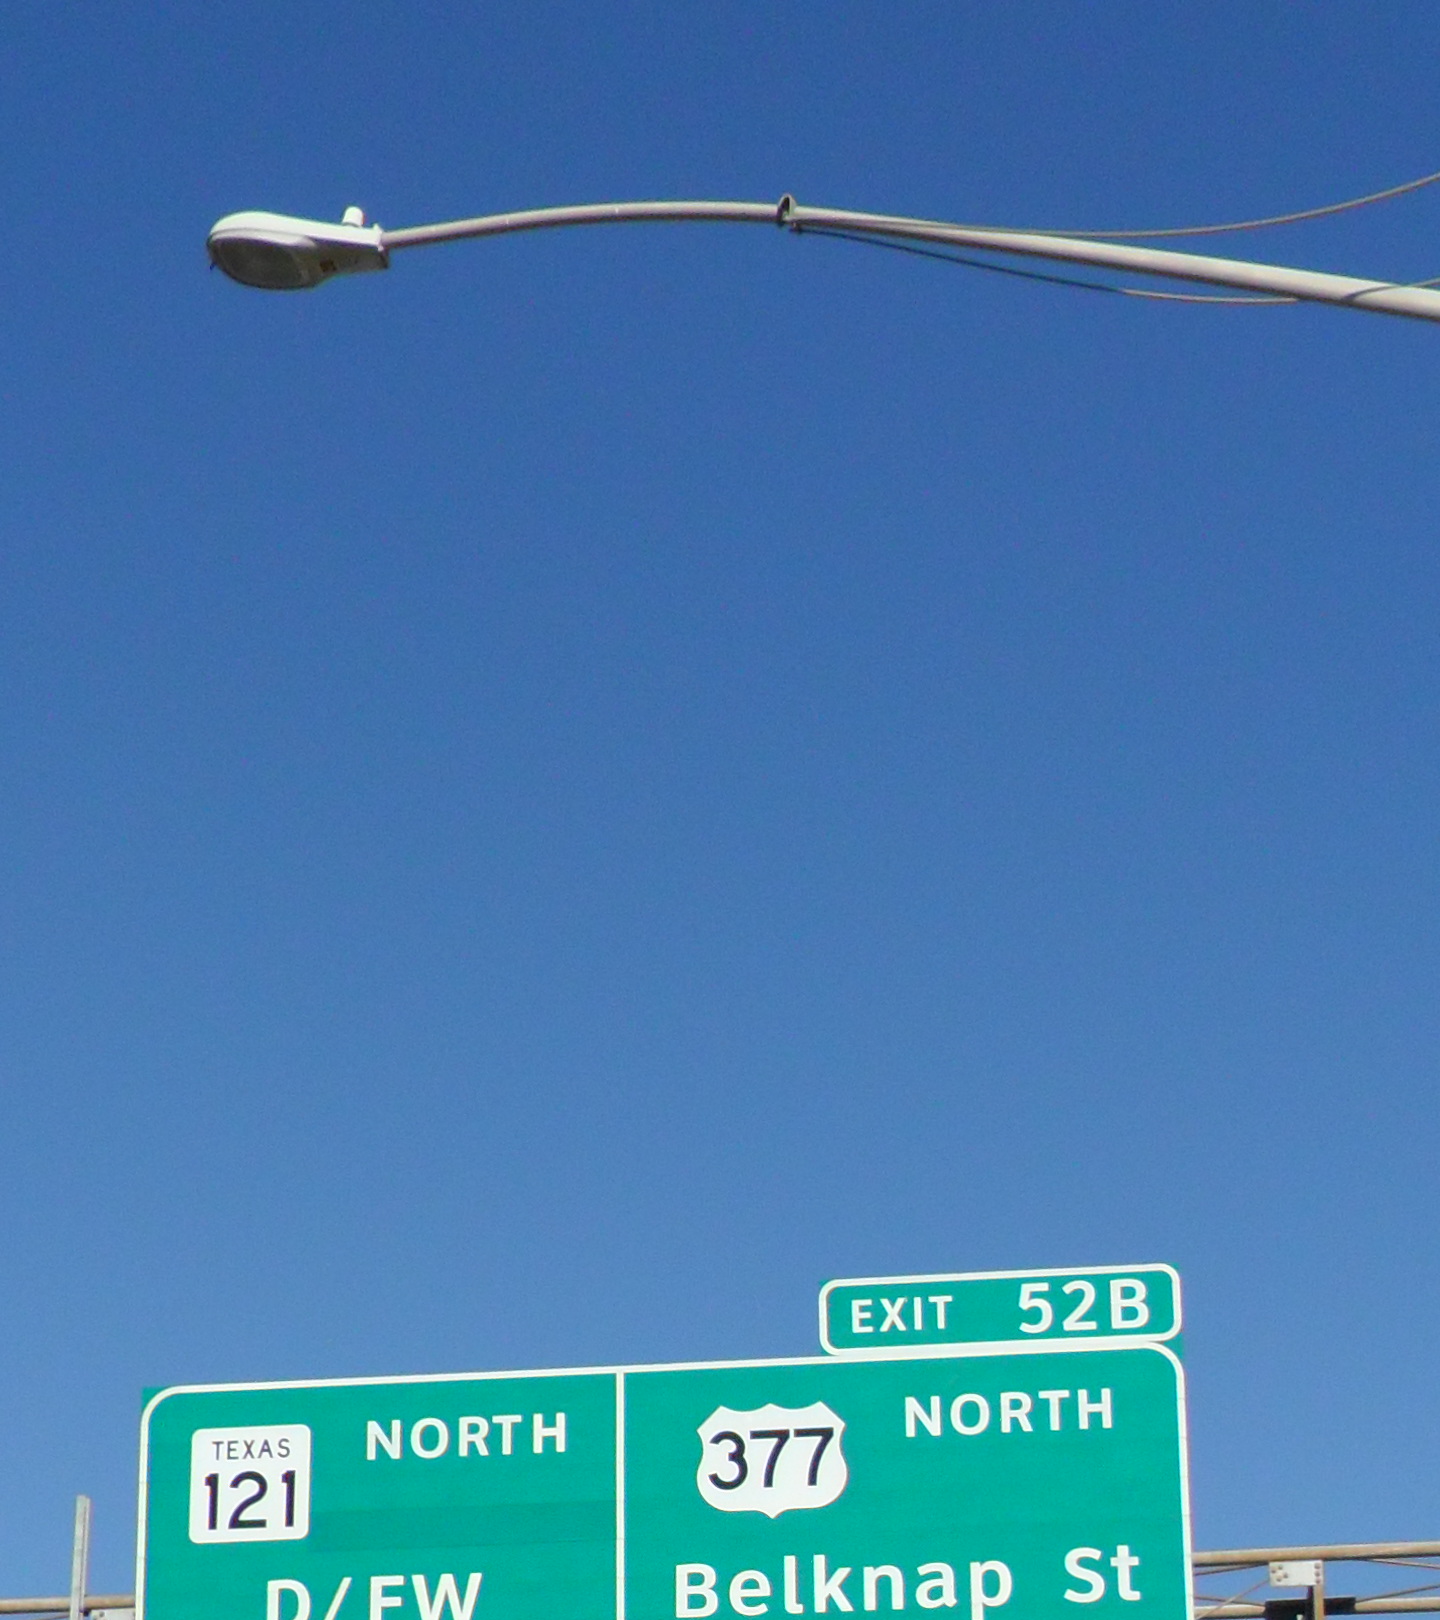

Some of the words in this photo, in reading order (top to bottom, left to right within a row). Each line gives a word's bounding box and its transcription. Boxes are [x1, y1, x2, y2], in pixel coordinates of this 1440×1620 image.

[851, 1295, 953, 1334] EXIT
[1017, 1278, 1150, 1334] 52B
[366, 1412, 568, 1461] NORTH
[905, 1387, 1114, 1438] NORTH
[212, 1438, 291, 1460] TEXAS
[709, 1427, 835, 1490] 377
[205, 1470, 297, 1530] 121
[1063, 1544, 1142, 1604] St
